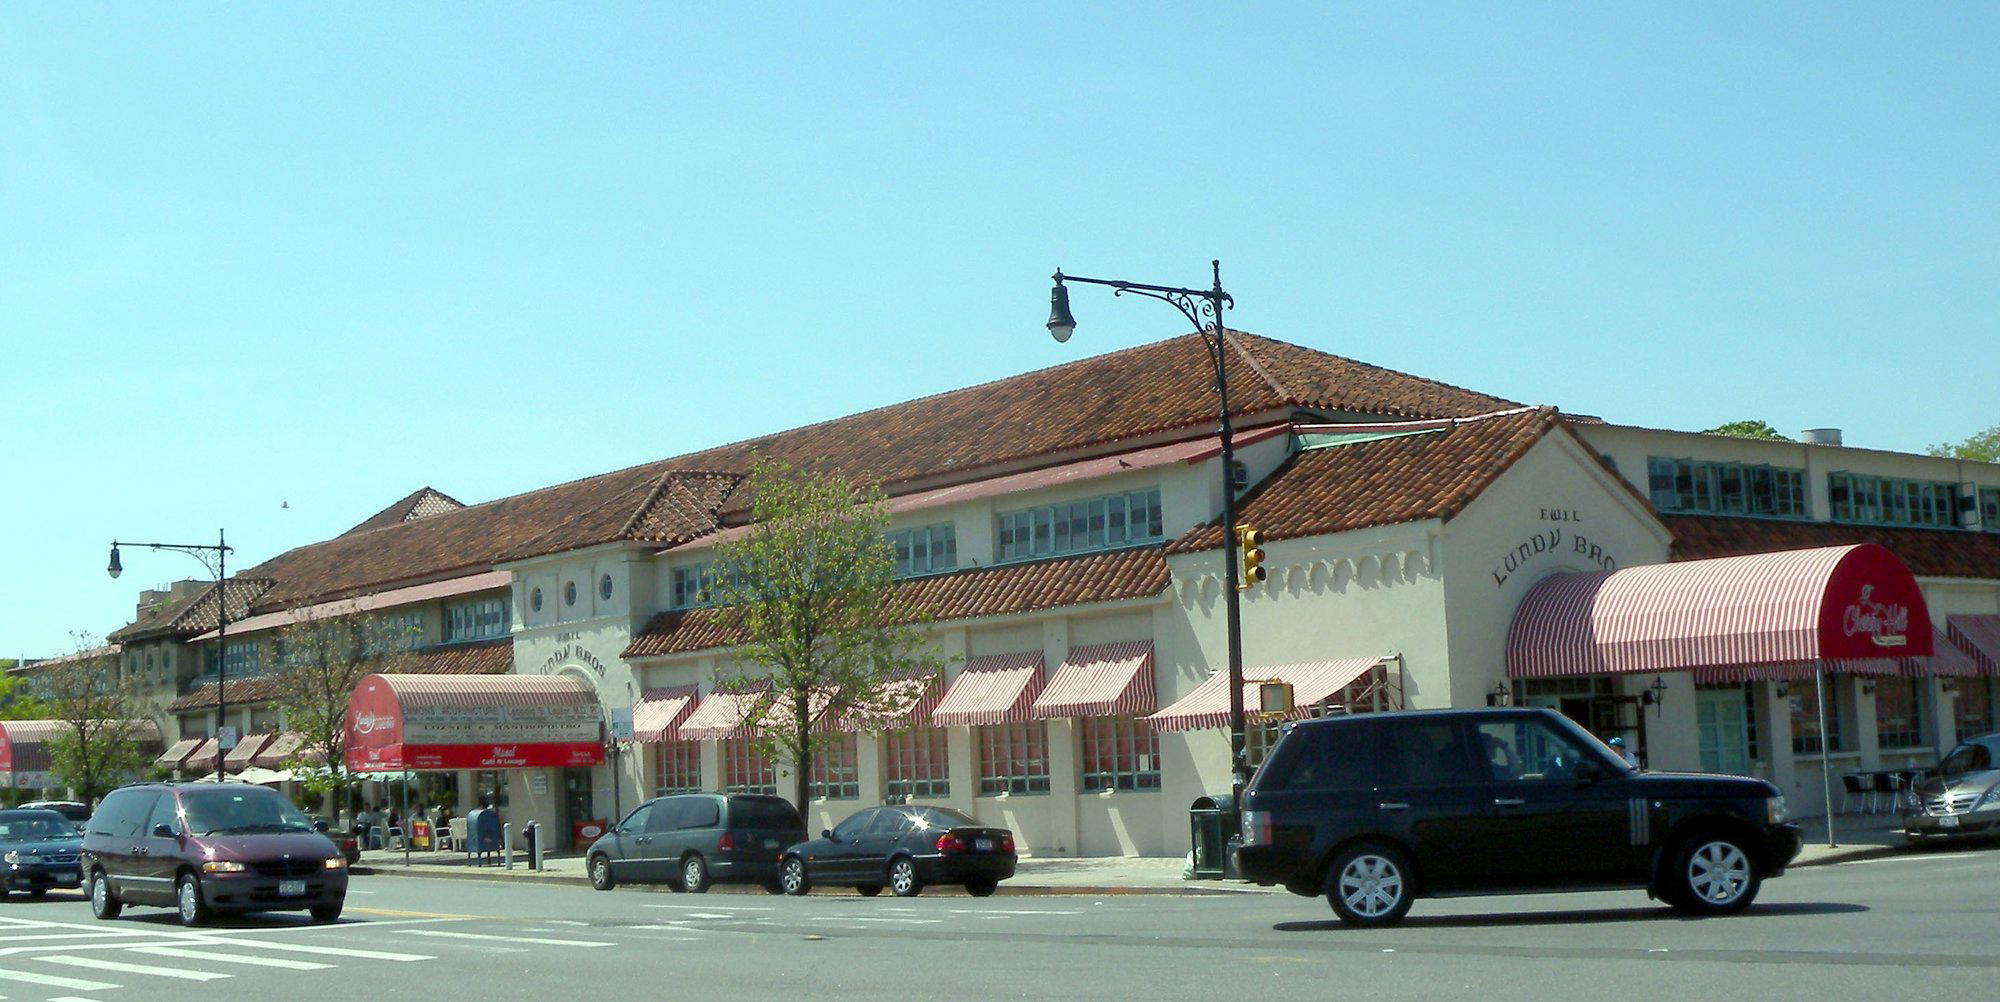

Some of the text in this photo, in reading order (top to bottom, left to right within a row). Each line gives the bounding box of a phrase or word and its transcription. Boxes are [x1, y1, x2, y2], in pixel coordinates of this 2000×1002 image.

[1492, 528, 1616, 588] LUNDY BRO
[540, 643, 607, 678] UNDY BROS
